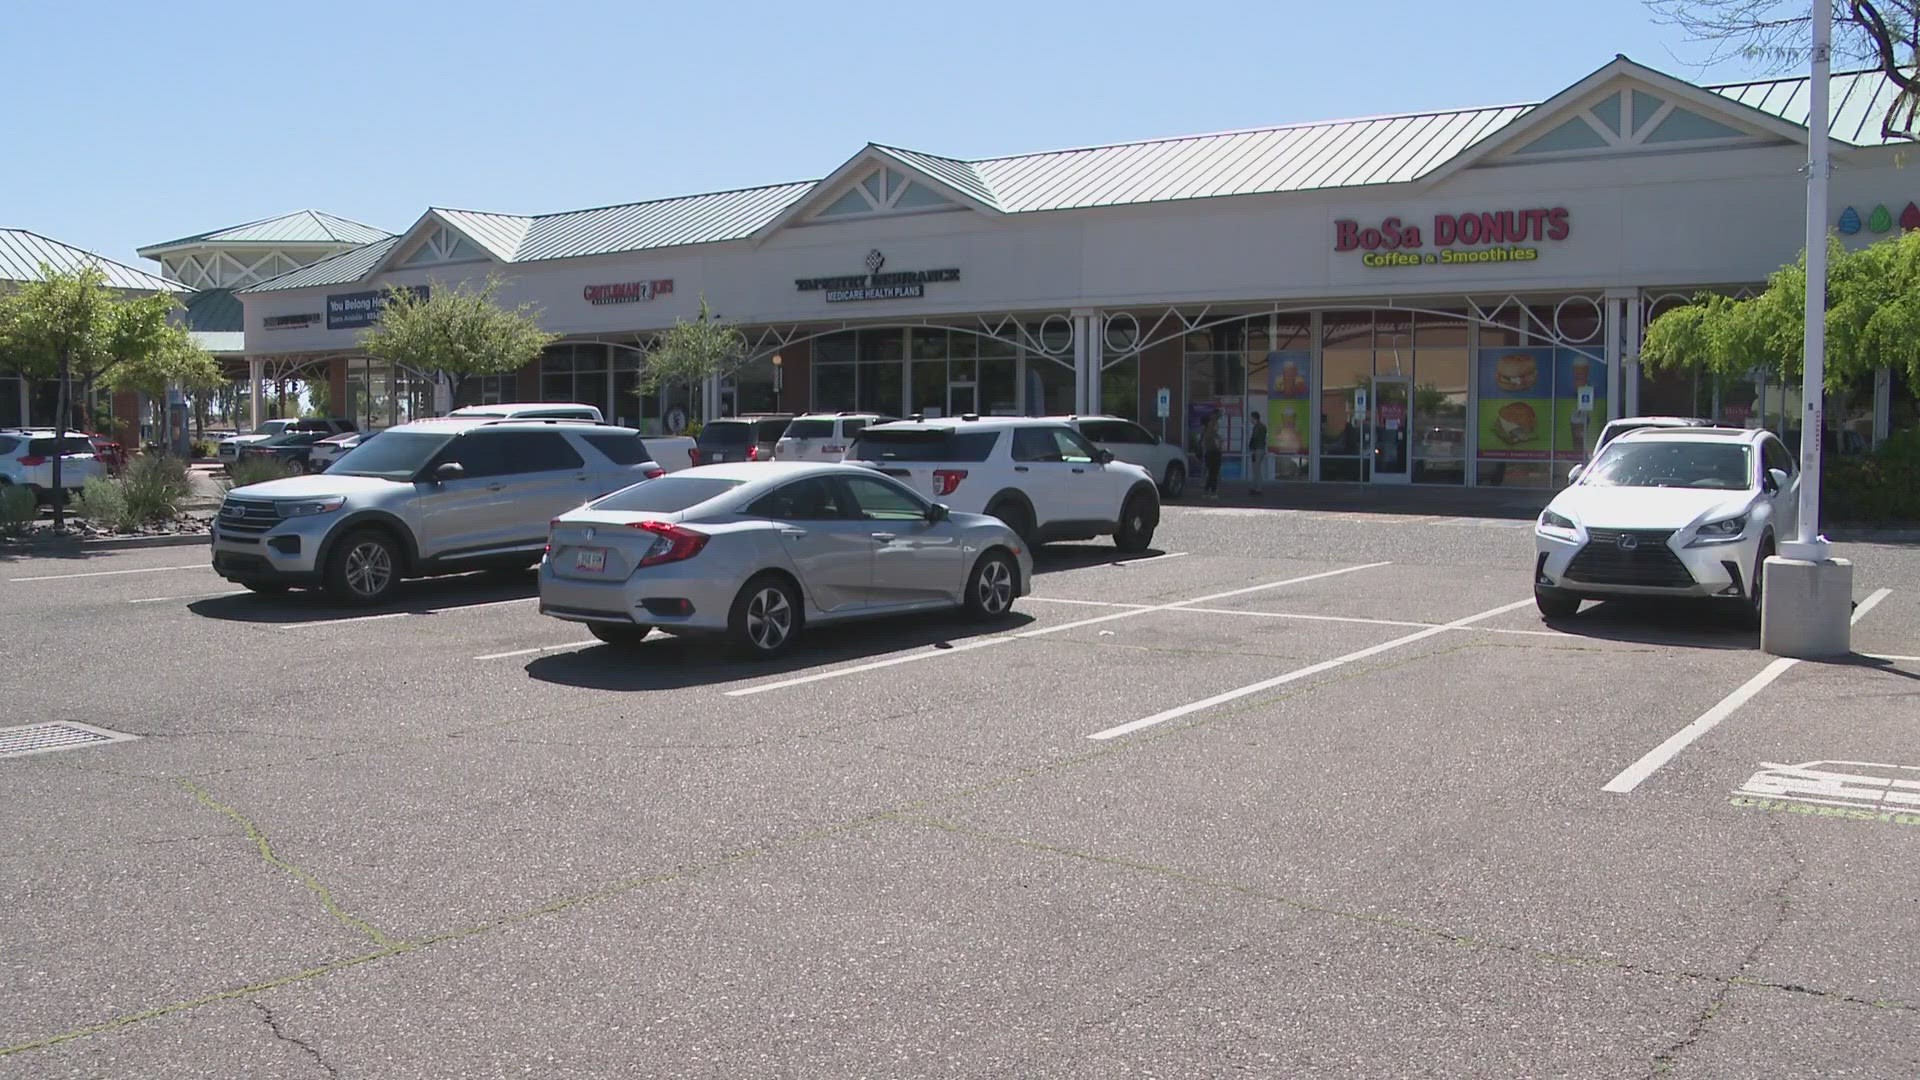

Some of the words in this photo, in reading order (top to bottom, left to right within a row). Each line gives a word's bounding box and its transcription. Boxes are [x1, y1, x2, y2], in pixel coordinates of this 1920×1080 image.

[1334, 216, 1423, 252] BoSa
[1434, 207, 1570, 246] DONUTS
[1362, 251, 1422, 268] Coffee
[1424, 253, 1437, 265] &
[1440, 246, 1538, 265] Smoothies
[870, 268, 961, 286] INSURANCE
[584, 282, 641, 301] GENTLEMAN
[827, 290, 864, 301] MEDICARE
[865, 287, 894, 299] HEALTH
[894, 285, 921, 297] PLANS
[330, 302, 344, 312] You
[345, 299, 371, 311] Belong
